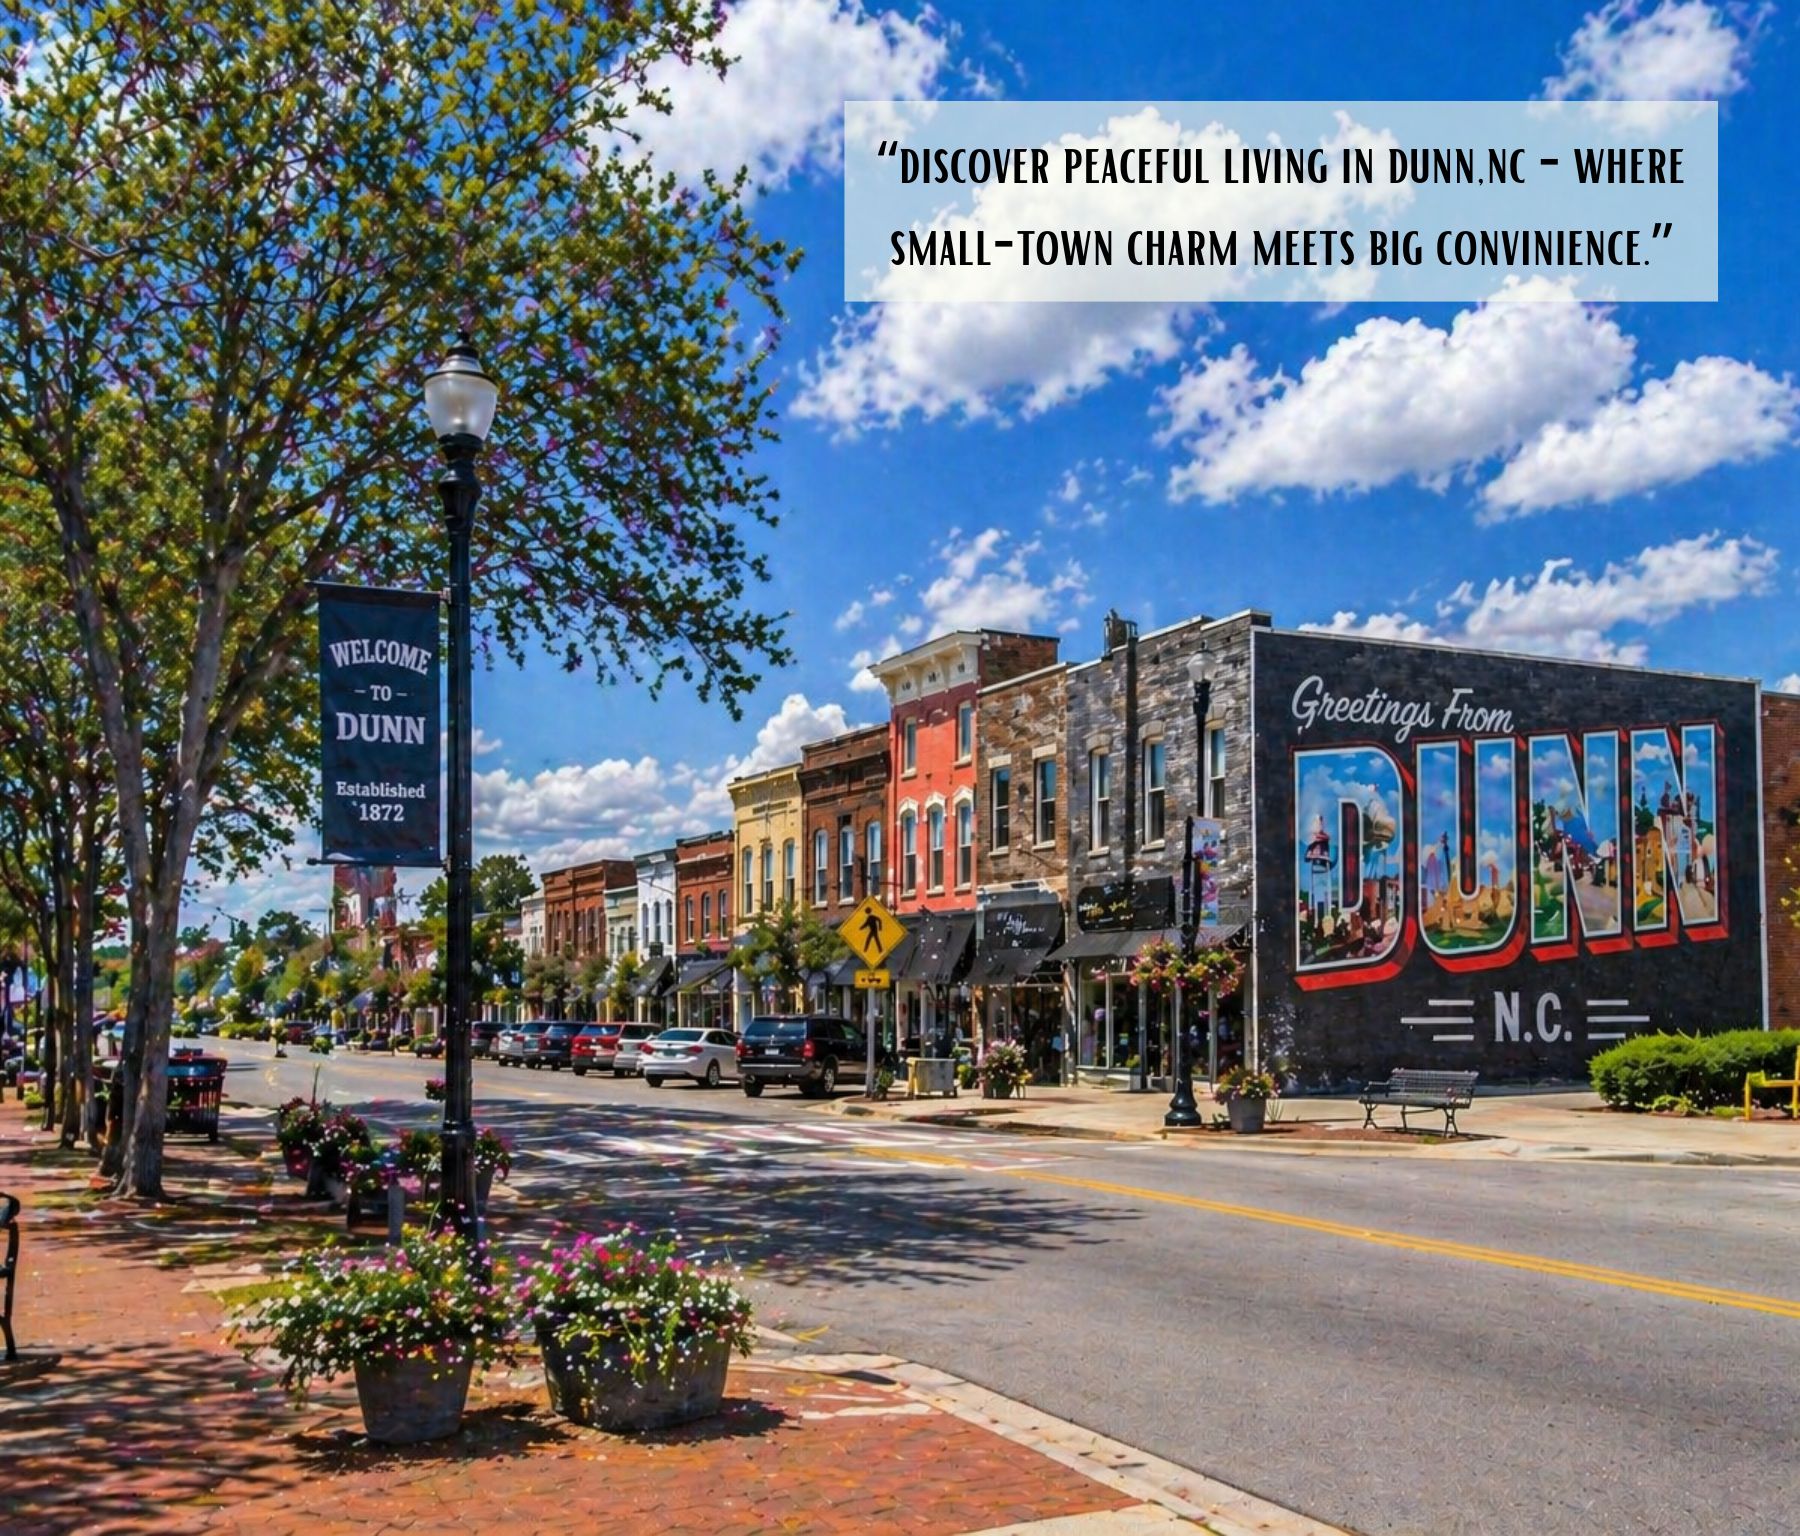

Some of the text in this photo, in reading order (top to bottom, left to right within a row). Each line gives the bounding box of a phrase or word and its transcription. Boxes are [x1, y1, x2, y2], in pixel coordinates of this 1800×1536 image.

[329, 638, 432, 676] WELCOME
[369, 684, 393, 702] TO
[1291, 675, 1514, 743] Greetings From
[335, 712, 427, 745] DUNN
[335, 780, 427, 799] Established
[358, 803, 405, 822] 1872
[1290, 720, 1729, 991] DUNN
[1494, 991, 1573, 1043] N.C.
